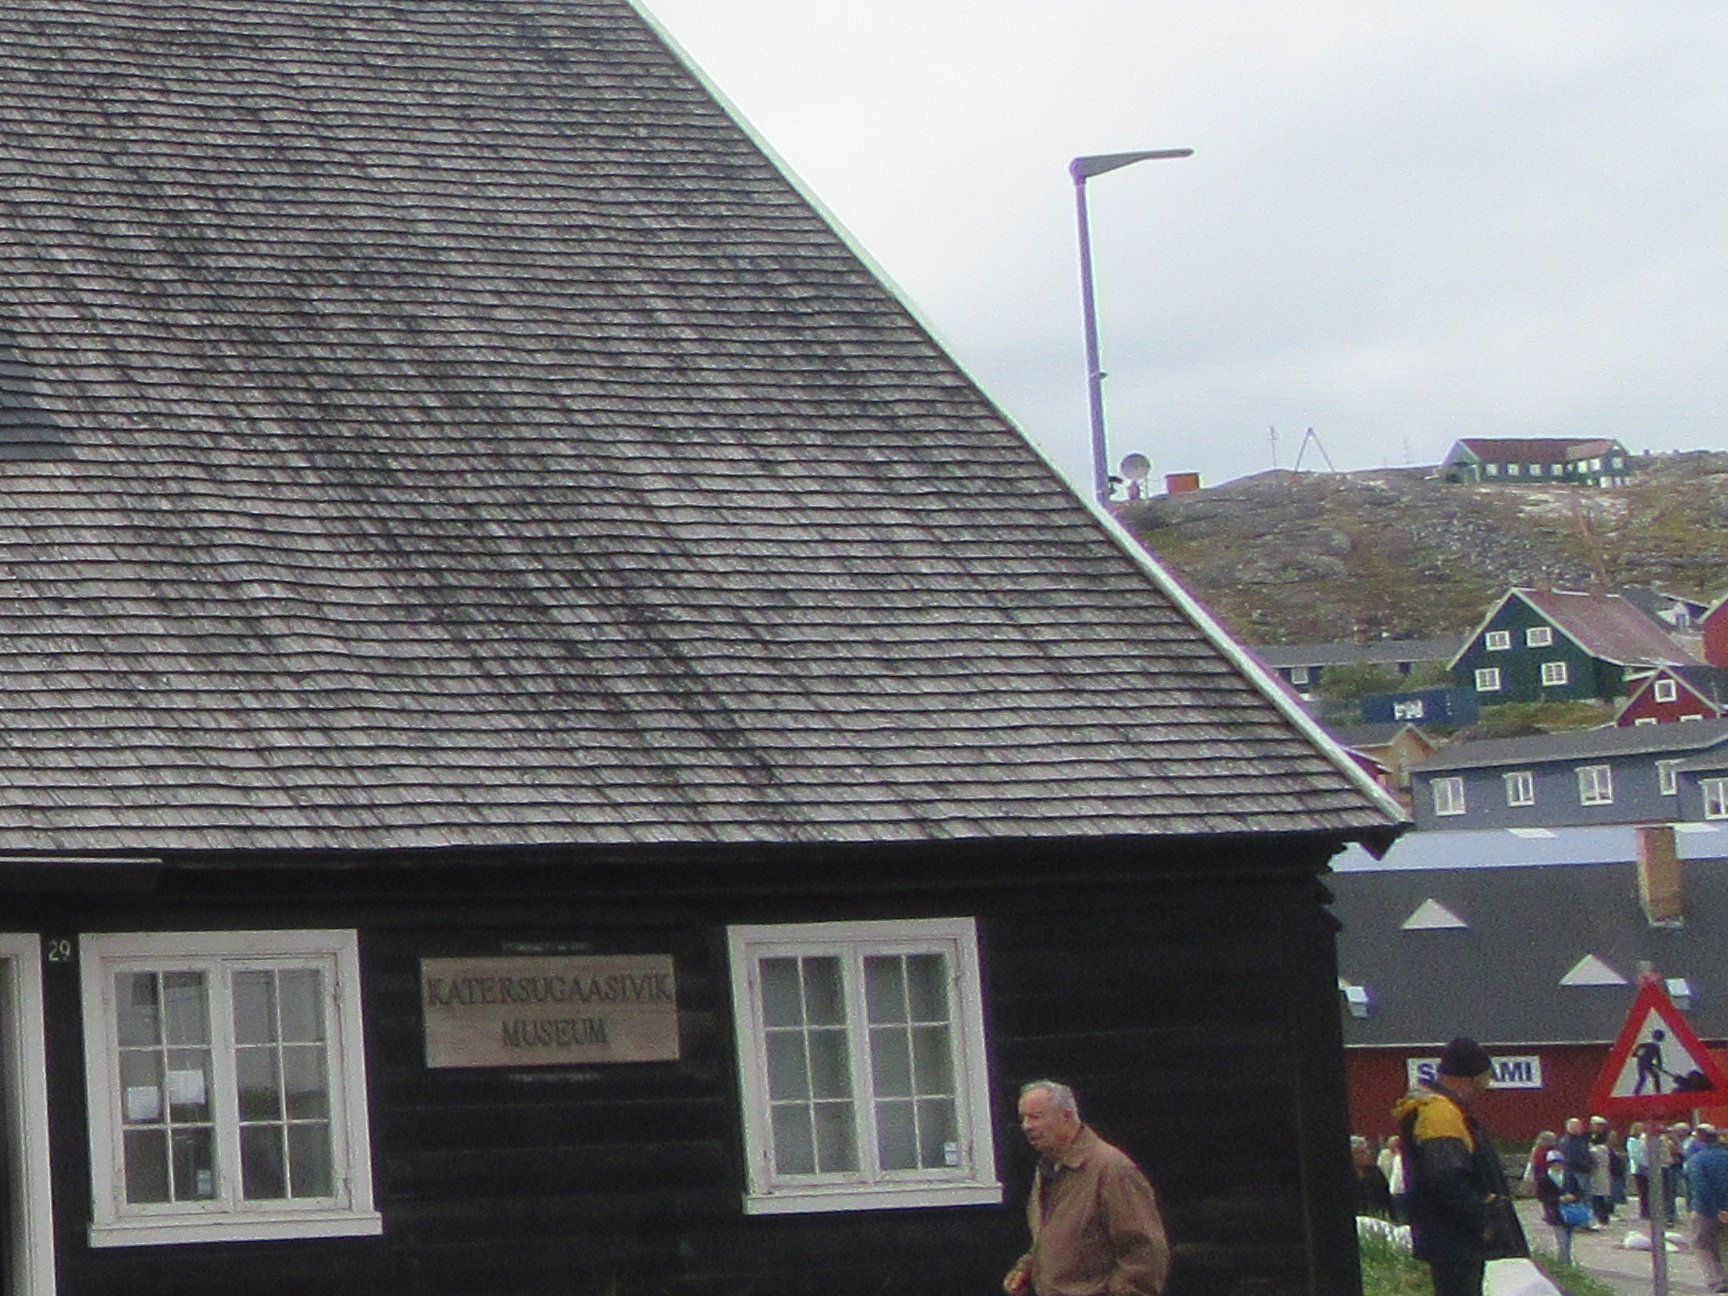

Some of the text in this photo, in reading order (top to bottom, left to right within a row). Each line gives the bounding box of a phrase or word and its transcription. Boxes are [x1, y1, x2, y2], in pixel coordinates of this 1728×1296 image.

[48, 939, 70, 961] 29
[426, 973, 674, 1006] KATERSUGAASIVIK
[501, 1018, 609, 1047] MUSEUM
